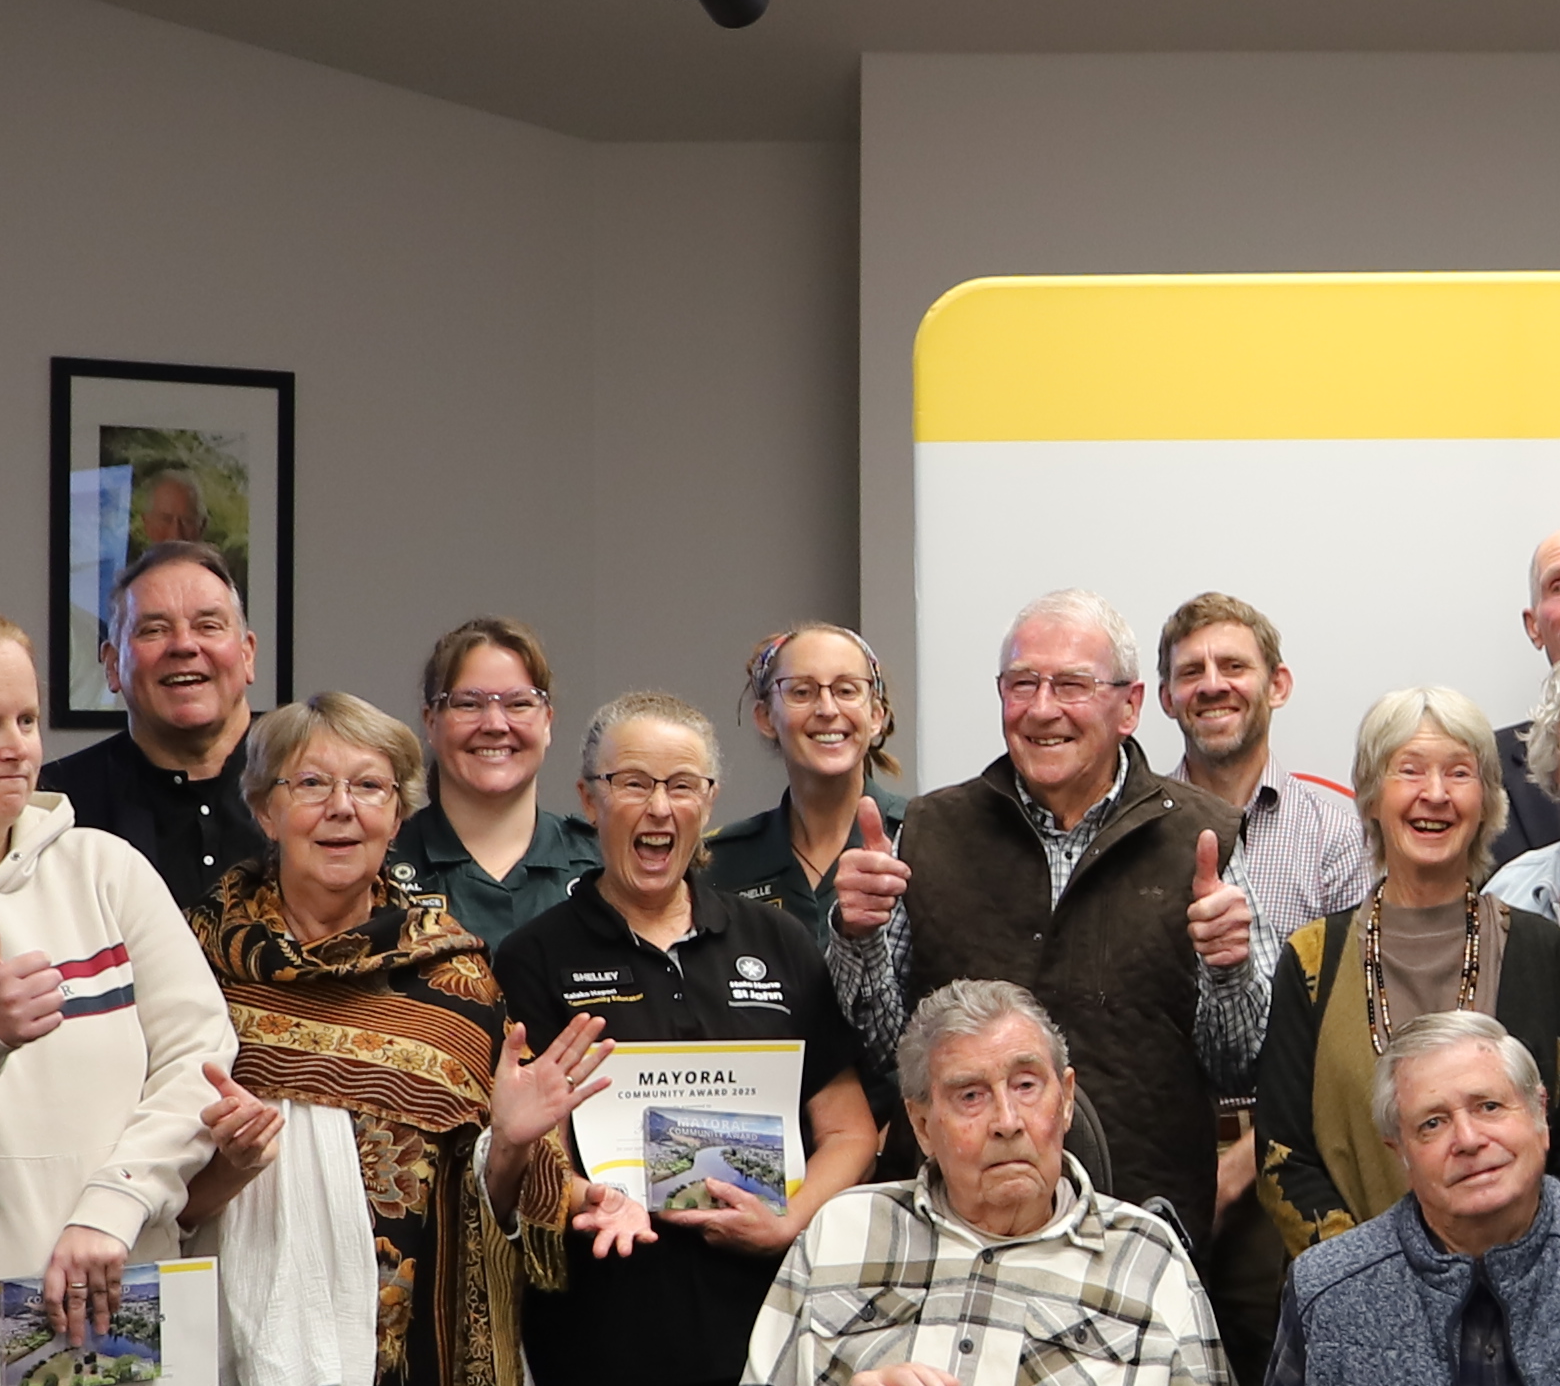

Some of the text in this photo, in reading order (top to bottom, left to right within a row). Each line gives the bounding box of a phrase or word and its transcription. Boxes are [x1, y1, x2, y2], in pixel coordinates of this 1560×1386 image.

[572, 970, 619, 983] SHELLEY
[732, 988, 784, 1002] St John
[638, 1070, 737, 1086] MAYORAL
[618, 1087, 757, 1099] COMMUNITY AWARD 2025
[677, 1117, 749, 1131] MAYORAL
[668, 1126, 758, 1141] COMMUNITY AWARD
